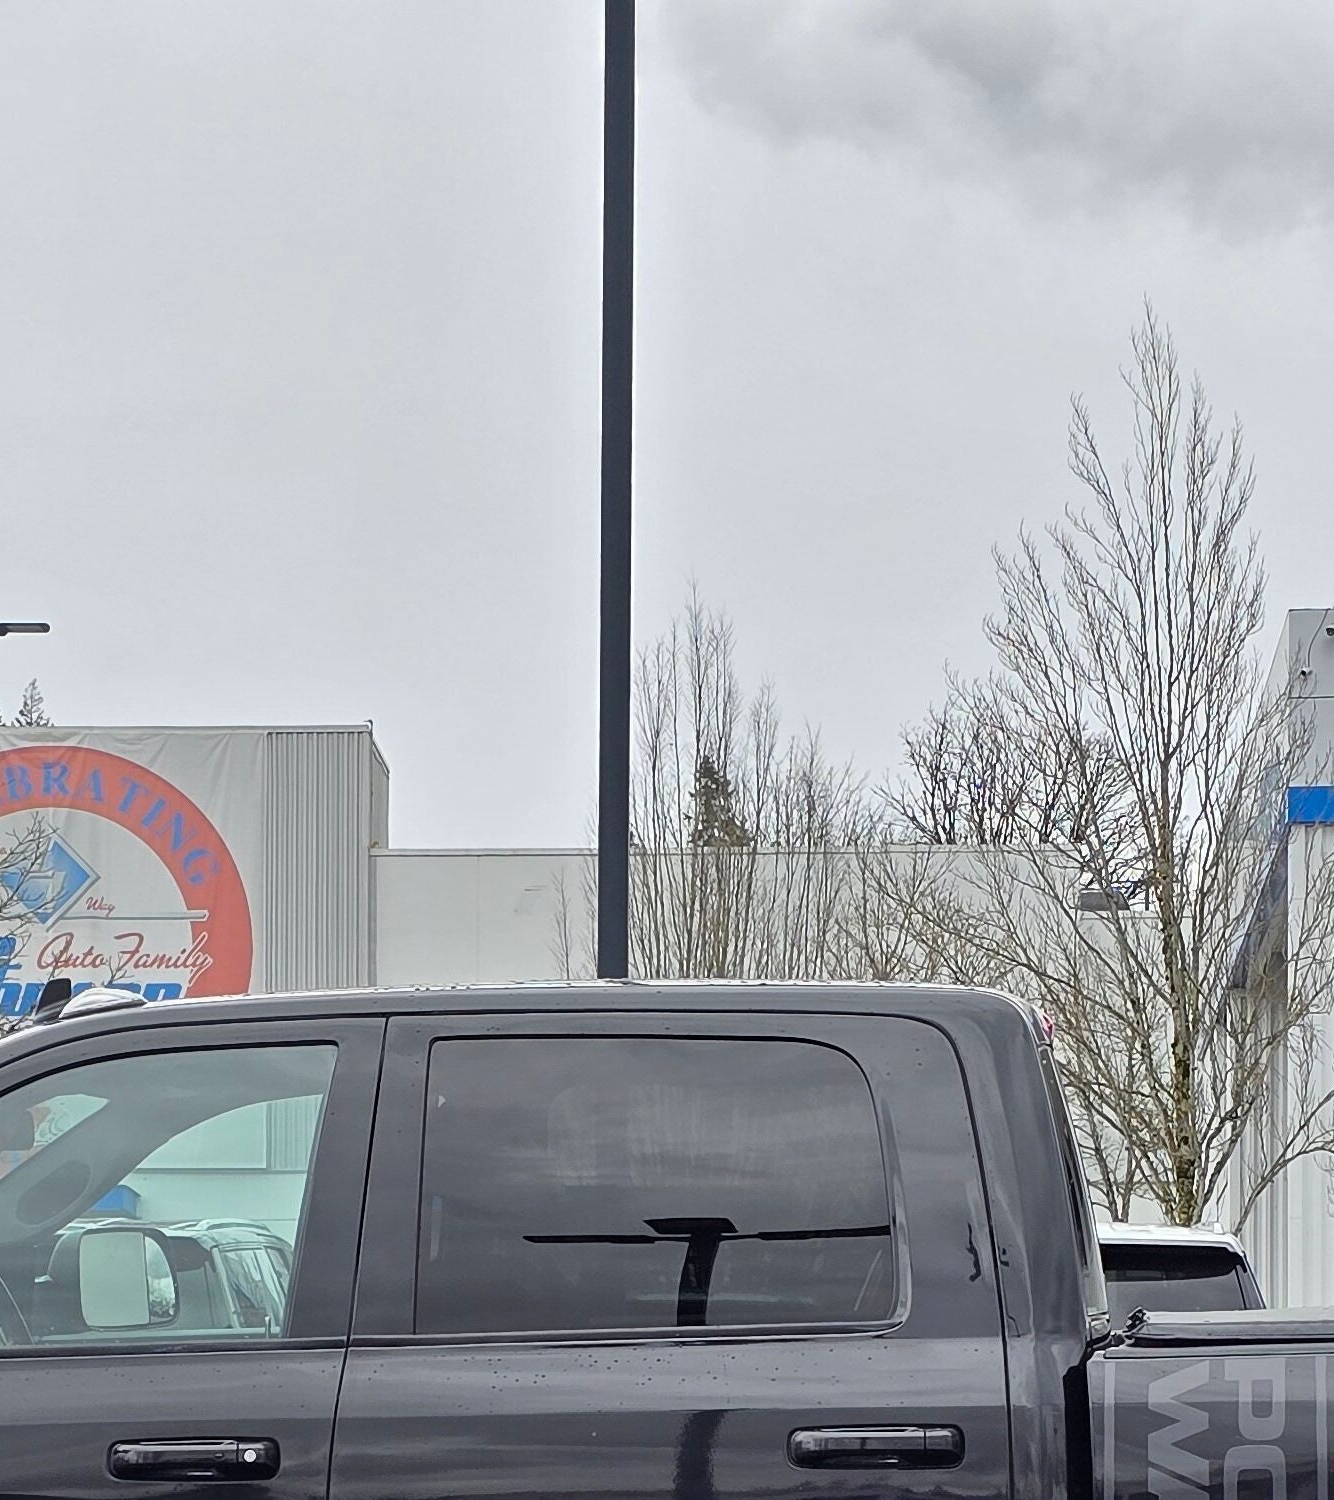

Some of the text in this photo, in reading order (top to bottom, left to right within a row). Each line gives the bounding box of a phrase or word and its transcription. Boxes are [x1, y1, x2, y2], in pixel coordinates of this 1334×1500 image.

[85, 896, 116, 918] Way
[37, 932, 212, 985] Auto Family
